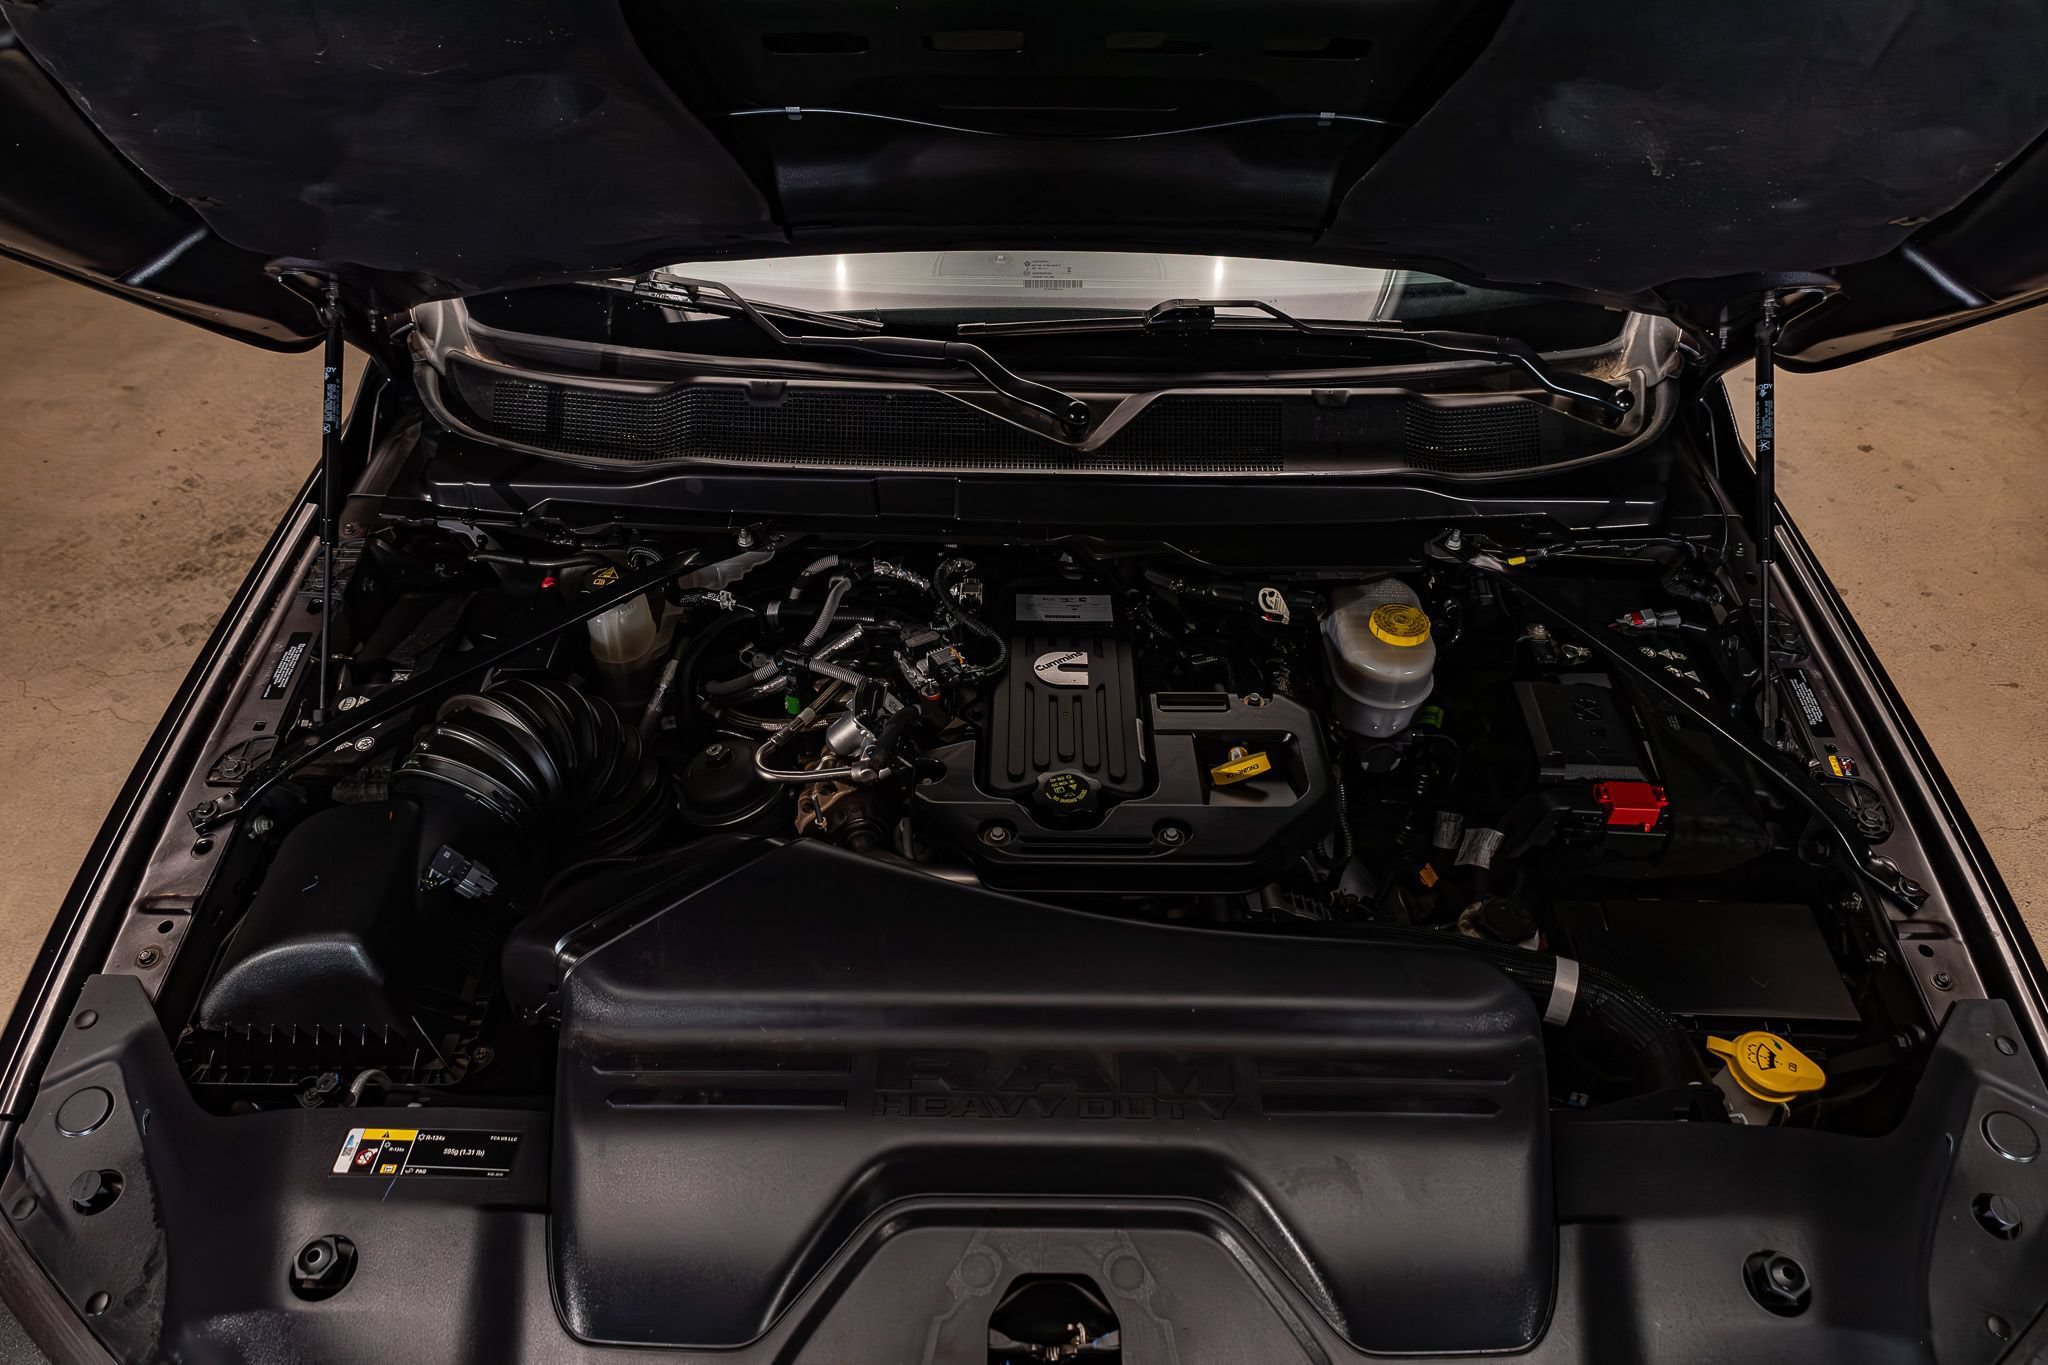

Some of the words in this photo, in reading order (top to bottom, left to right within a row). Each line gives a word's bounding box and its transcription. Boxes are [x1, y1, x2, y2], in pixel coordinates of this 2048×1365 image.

[1035, 651, 1084, 671] Cummins
[1237, 763, 1260, 775] ENGINE
[875, 1049, 1235, 1093] RAM
[871, 1093, 1068, 1119] HEAVY
[1075, 1094, 1236, 1120] DUTY
[443, 1147, 459, 1156] 595g
[459, 1148, 475, 1156] (1.31
[475, 1149, 485, 1158] lb)
